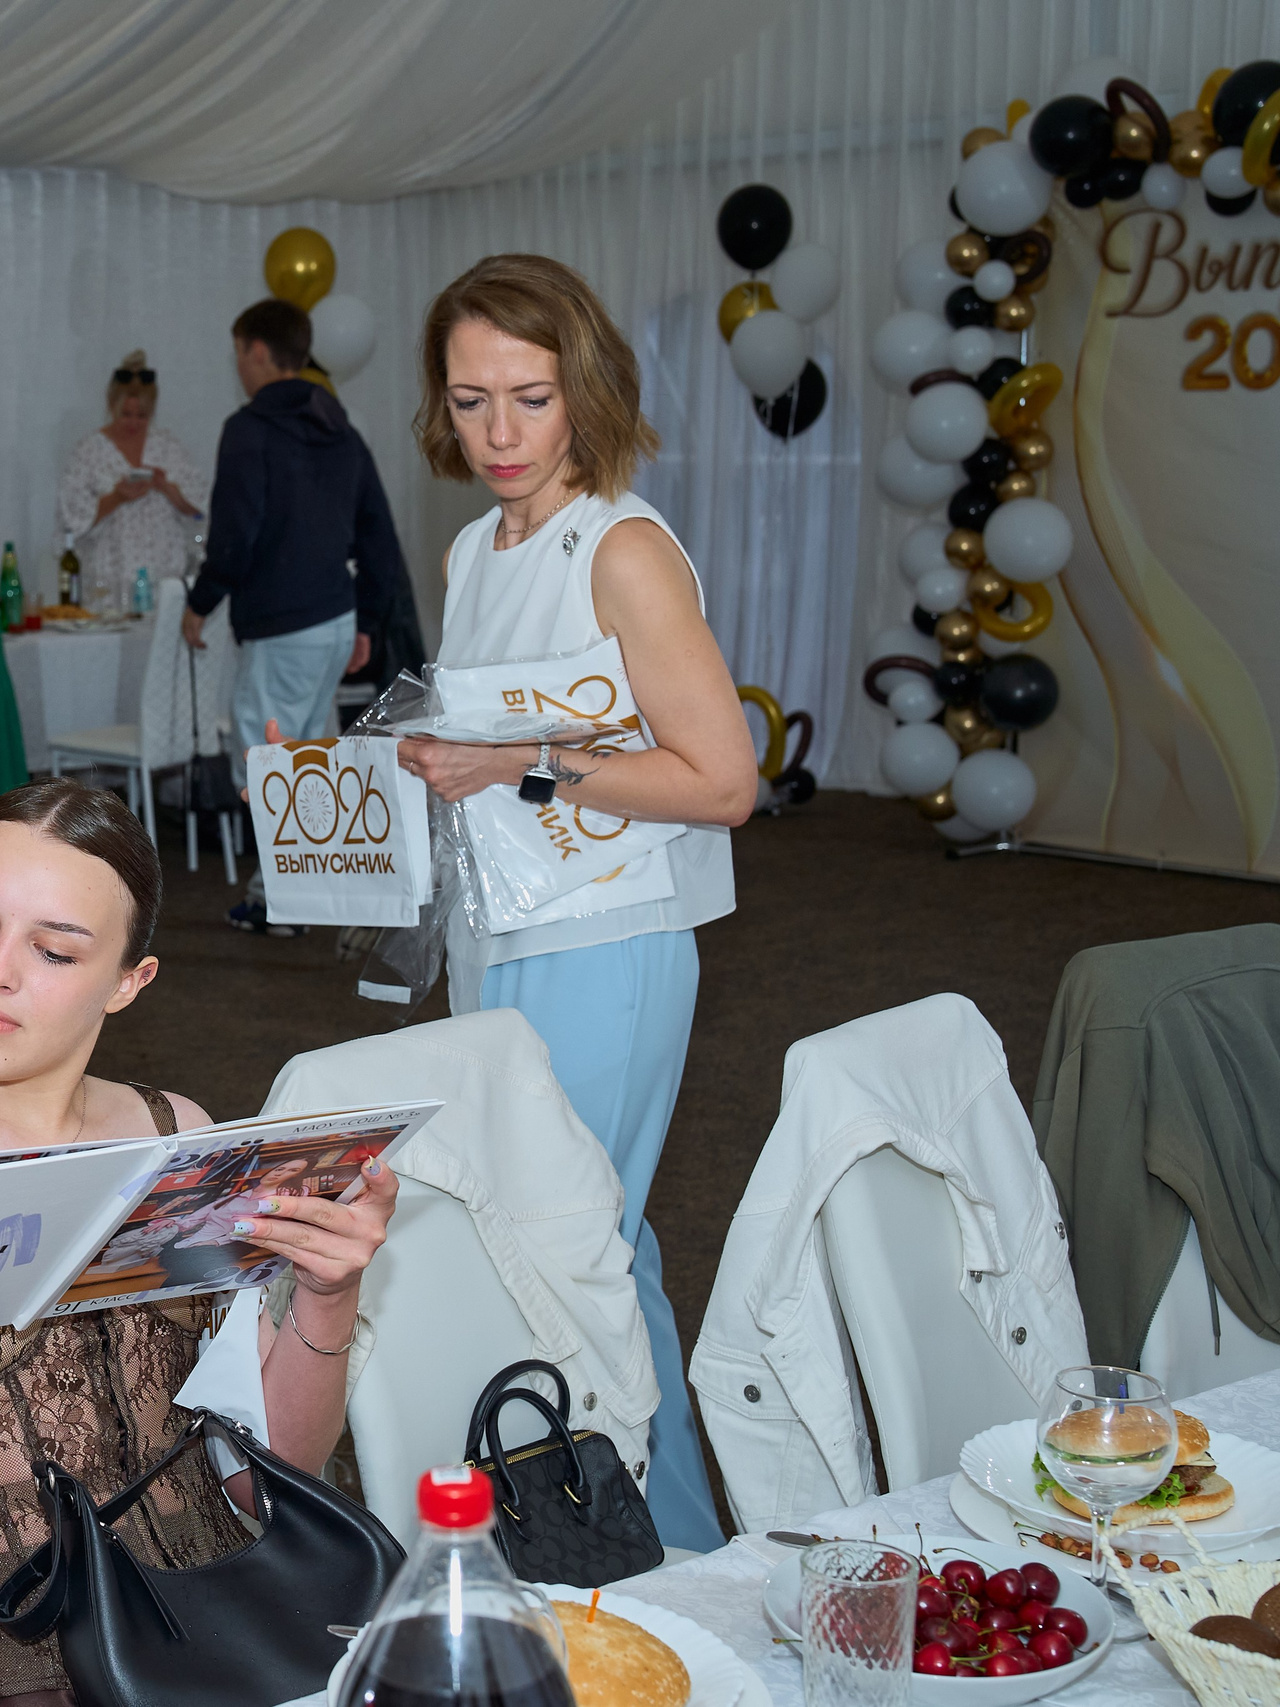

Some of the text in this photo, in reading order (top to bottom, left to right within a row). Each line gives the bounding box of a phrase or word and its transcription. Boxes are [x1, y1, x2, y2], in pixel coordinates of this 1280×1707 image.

[1182, 313, 1280, 392] 20
[262, 764, 391, 846] 2026
[274, 853, 396, 874] ВЫПУСКНИК
[292, 1122, 338, 1133] МАОУ
[340, 1115, 382, 1126] «СОШ
[158, 1149, 233, 1175] 20
[190, 1261, 278, 1292] 26
[53, 1293, 136, 1315] 9Г КЛАСС
